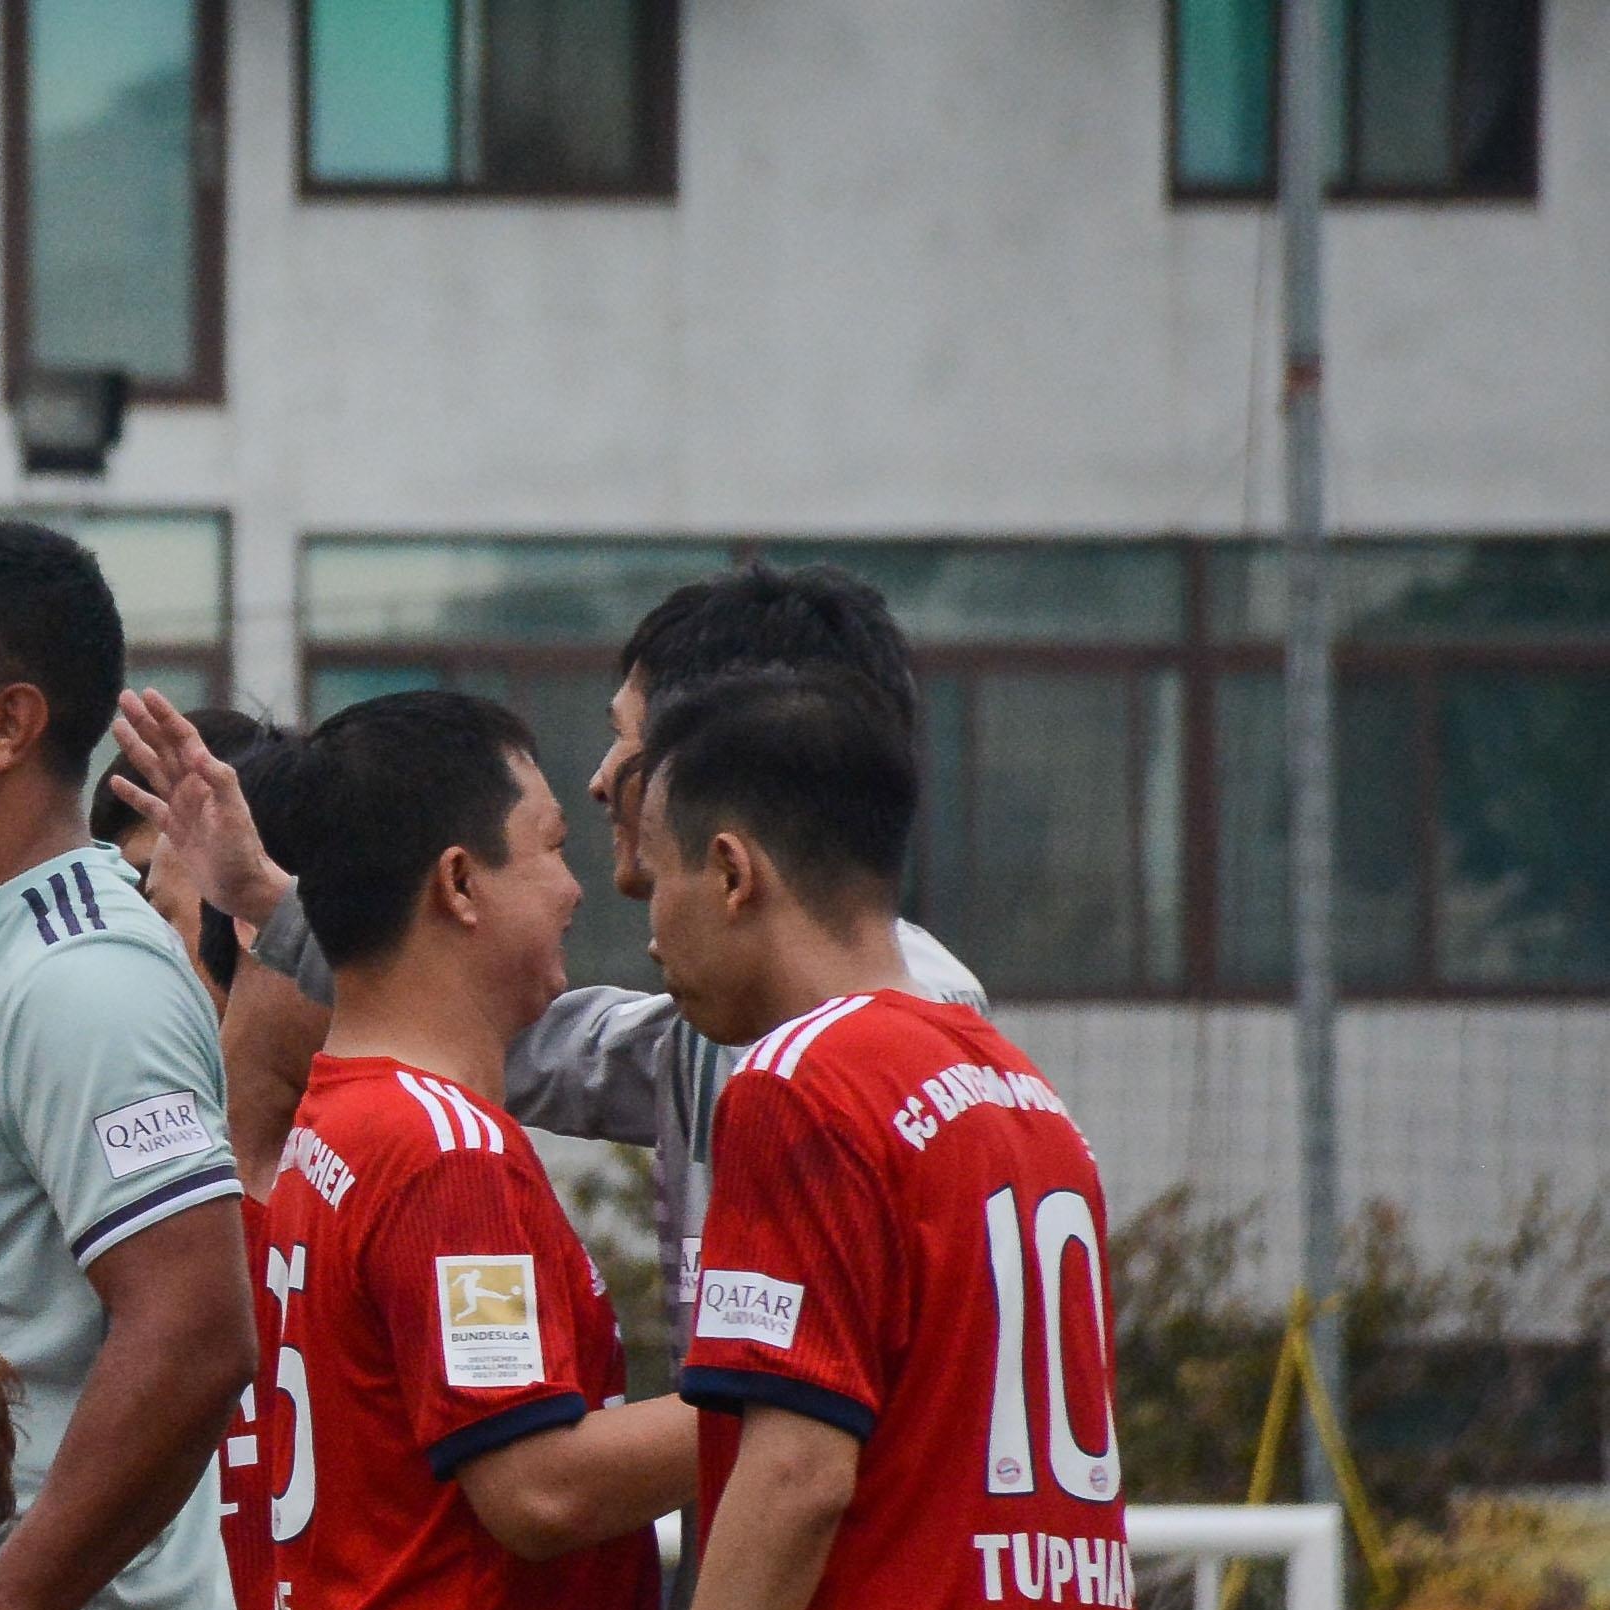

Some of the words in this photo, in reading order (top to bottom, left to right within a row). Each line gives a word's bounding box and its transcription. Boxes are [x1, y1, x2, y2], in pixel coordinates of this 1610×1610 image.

[106, 1104, 195, 1149] QATAR
[137, 1127, 202, 1154] AIRWAYS
[892, 1096, 939, 1151] FC
[706, 1283, 794, 1320] QATAR
[451, 1330, 530, 1342] BUNDESLIGA
[723, 1311, 790, 1336] AIRWAYS
[984, 1184, 1122, 1502] 10
